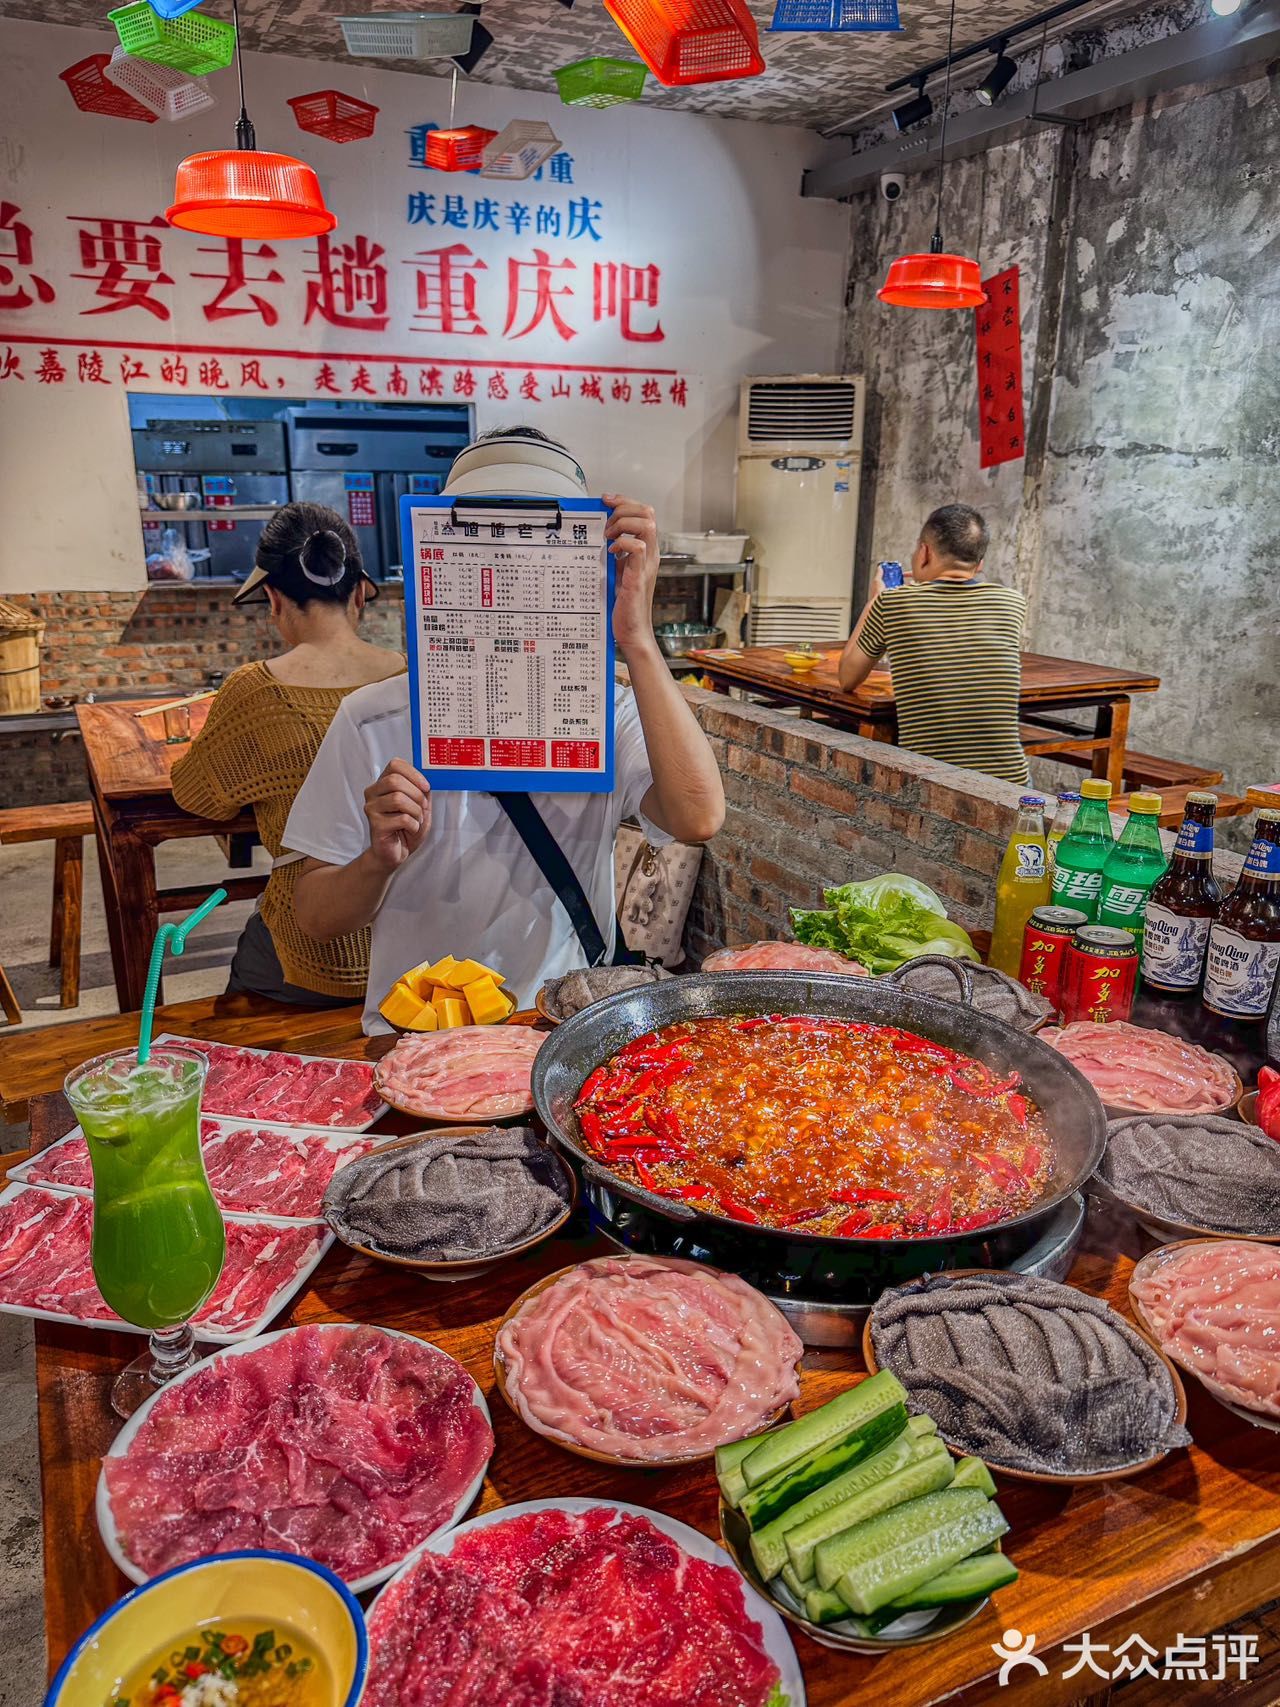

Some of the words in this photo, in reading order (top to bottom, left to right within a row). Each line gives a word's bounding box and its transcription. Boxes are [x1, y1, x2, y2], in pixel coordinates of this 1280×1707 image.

[420, 547, 445, 561] 锅底
[1051, 867, 1103, 900] 雪碧
[1103, 884, 1149, 917] 雪
